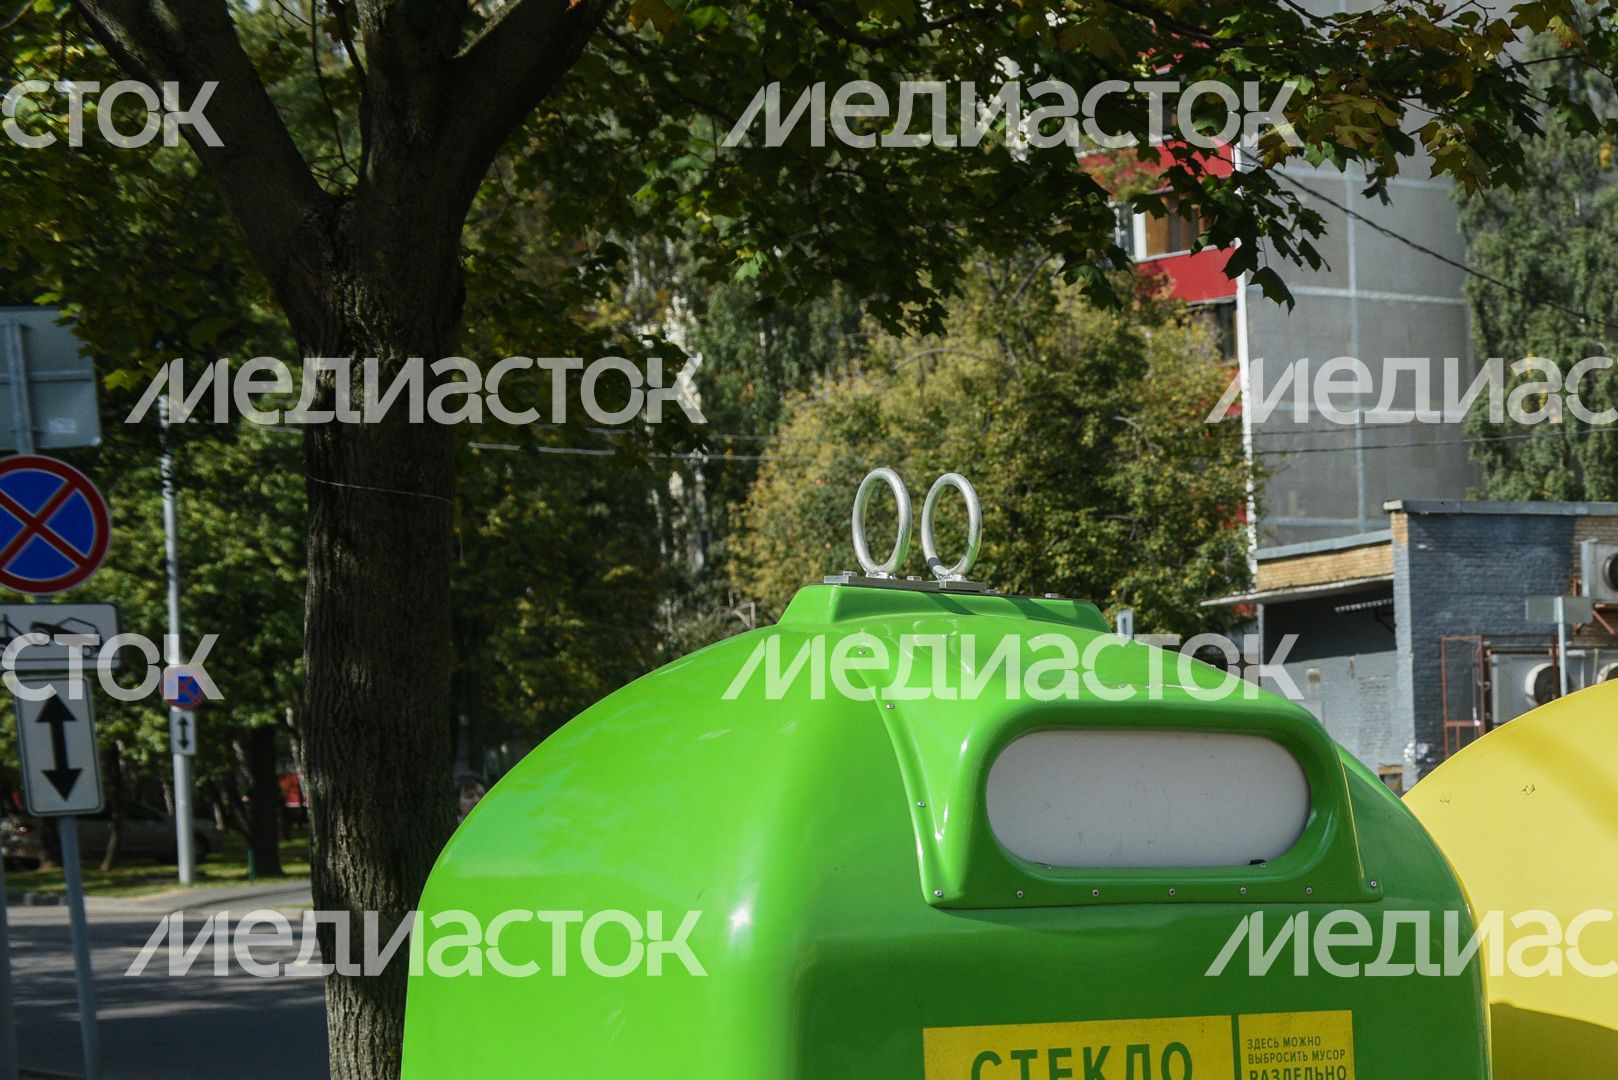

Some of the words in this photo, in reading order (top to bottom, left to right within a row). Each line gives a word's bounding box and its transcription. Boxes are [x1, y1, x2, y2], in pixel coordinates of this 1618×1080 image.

[1247, 1037, 1279, 1050] ЗДЕСЬ
[1283, 1035, 1320, 1047] МОЖНО
[1248, 1050, 1308, 1064] ВЫБРОСИТЬ
[1311, 1048, 1345, 1060] МУСОР
